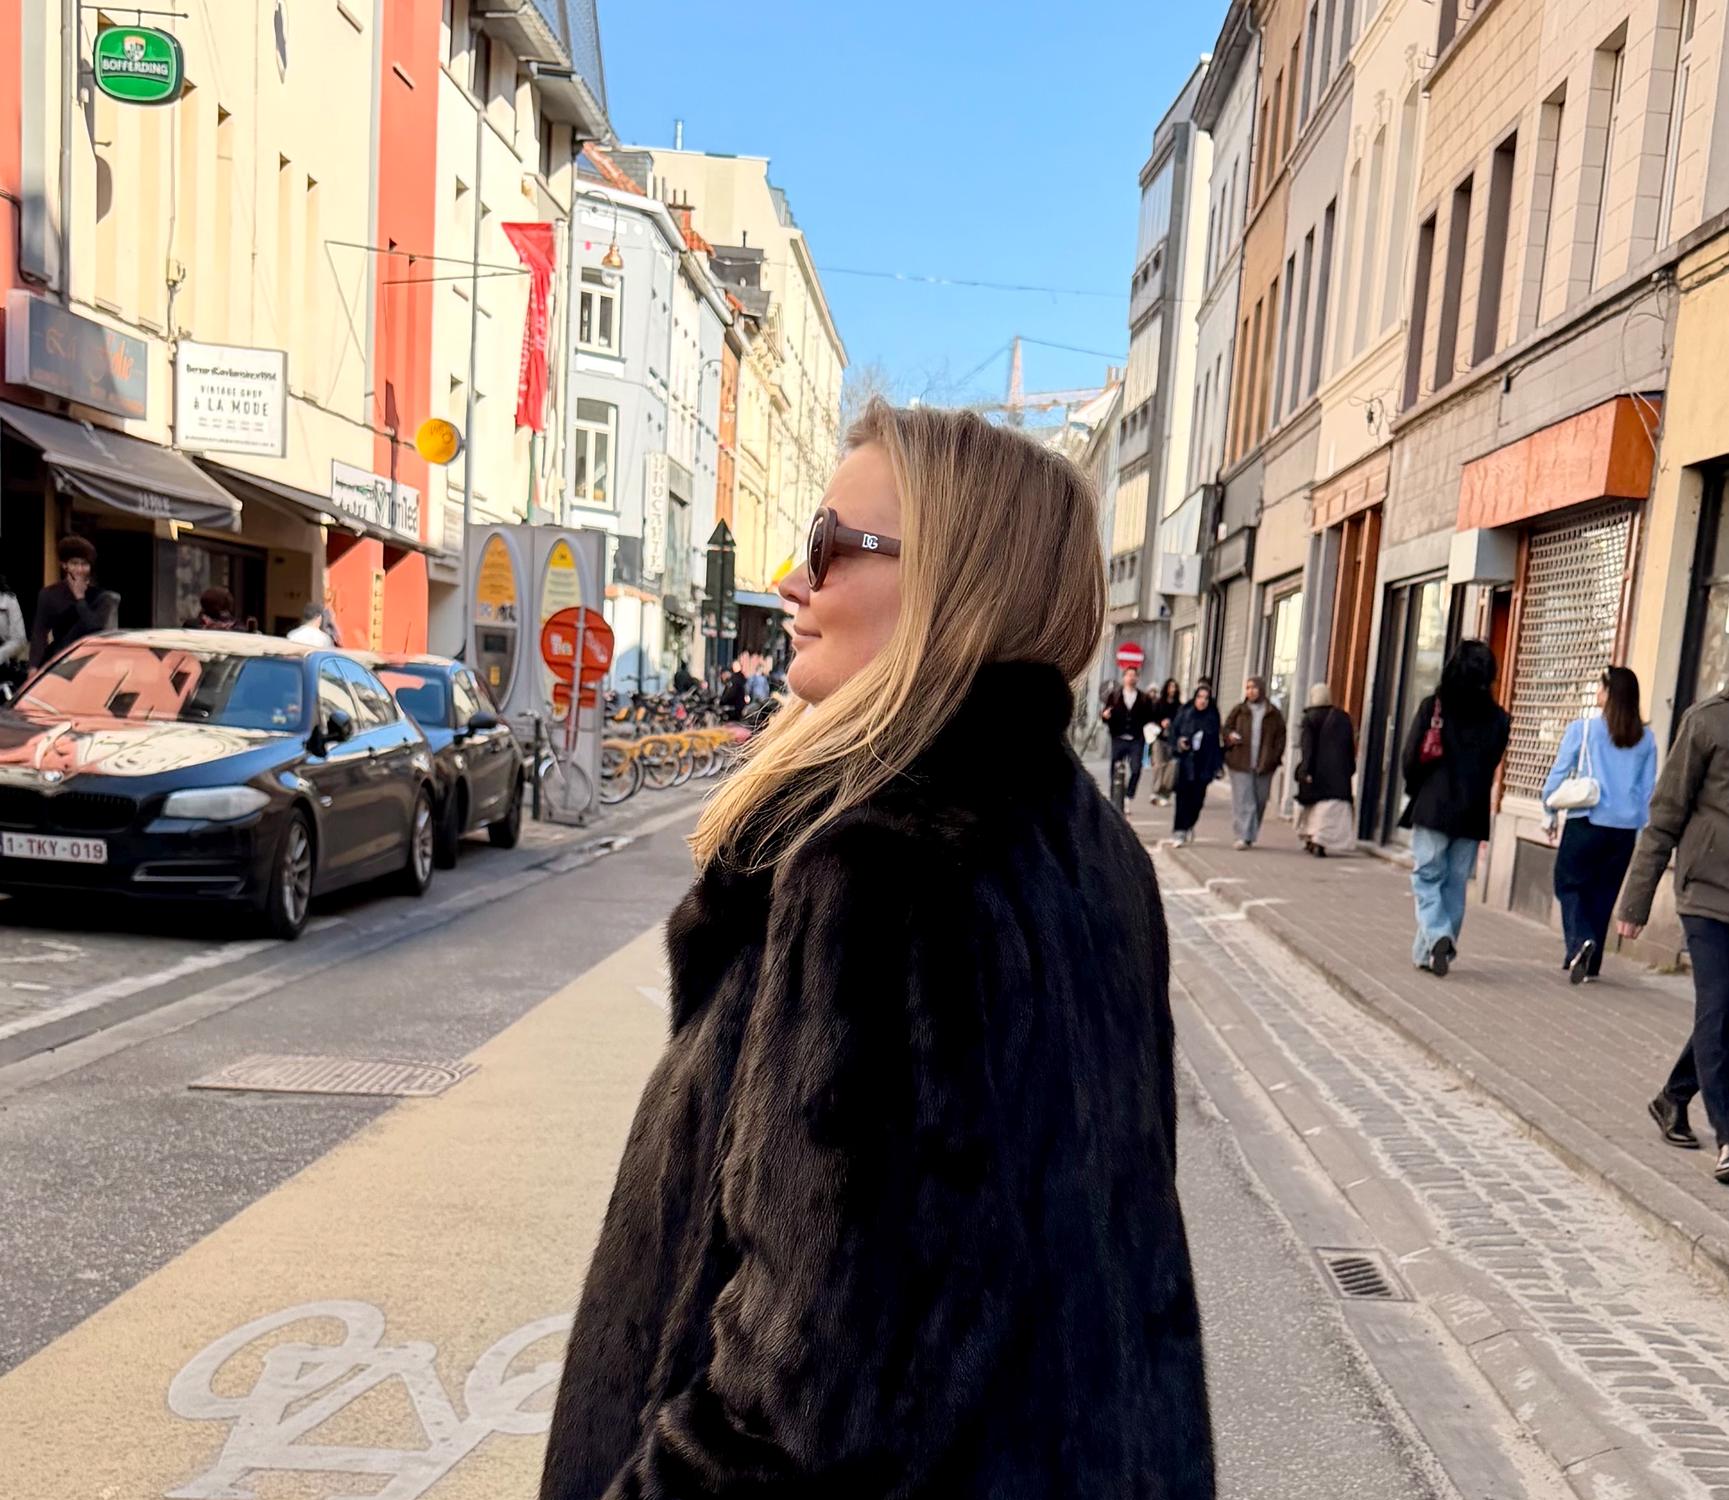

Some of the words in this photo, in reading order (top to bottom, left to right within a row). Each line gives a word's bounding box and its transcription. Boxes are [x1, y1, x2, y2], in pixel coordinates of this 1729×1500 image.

[102, 58, 168, 75] BOFFERDING
[200, 385, 236, 396] VINTAGE
[208, 398, 224, 412] LA
[231, 400, 268, 416] MODE
